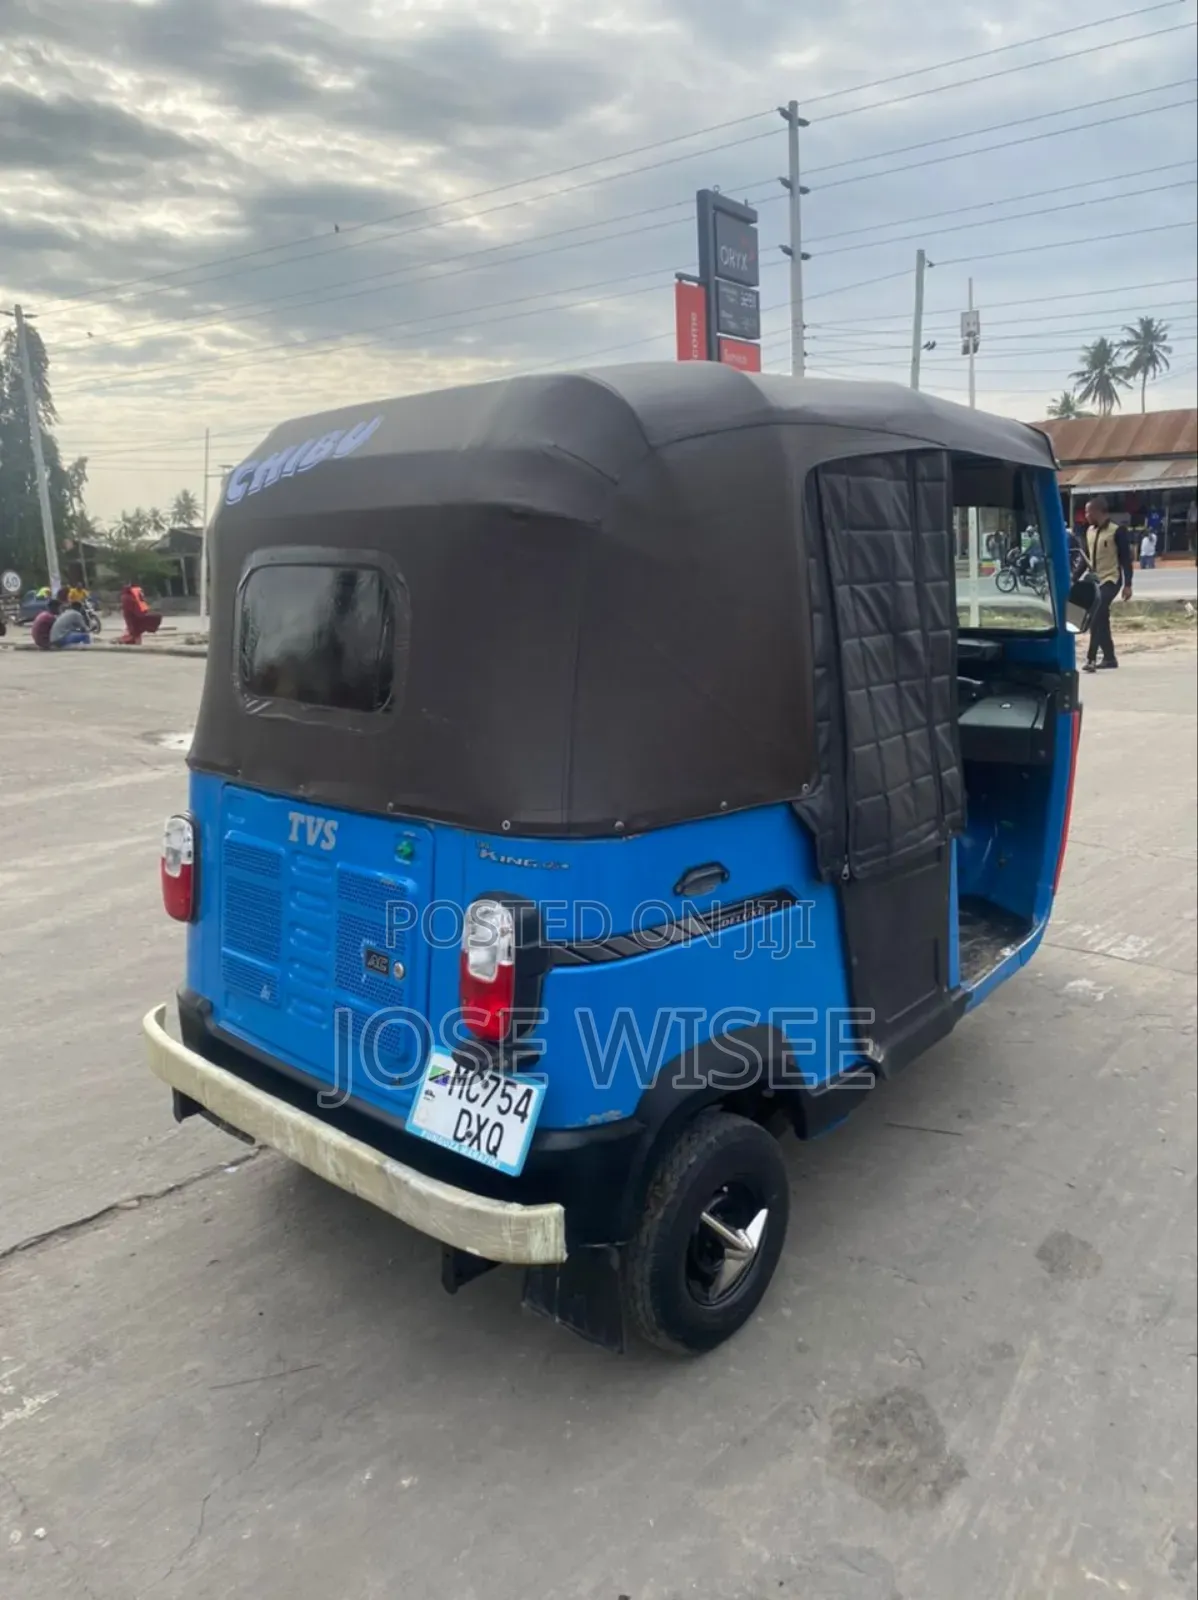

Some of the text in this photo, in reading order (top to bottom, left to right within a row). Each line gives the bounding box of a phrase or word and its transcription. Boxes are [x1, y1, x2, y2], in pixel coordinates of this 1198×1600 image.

[720, 245, 748, 271] ORYX
[225, 414, 384, 505] CHIBU
[6, 576, 18, 588] 60
[288, 811, 338, 851] TVS
[448, 1063, 535, 1124] MC754
[453, 1108, 505, 1158] DXQ
